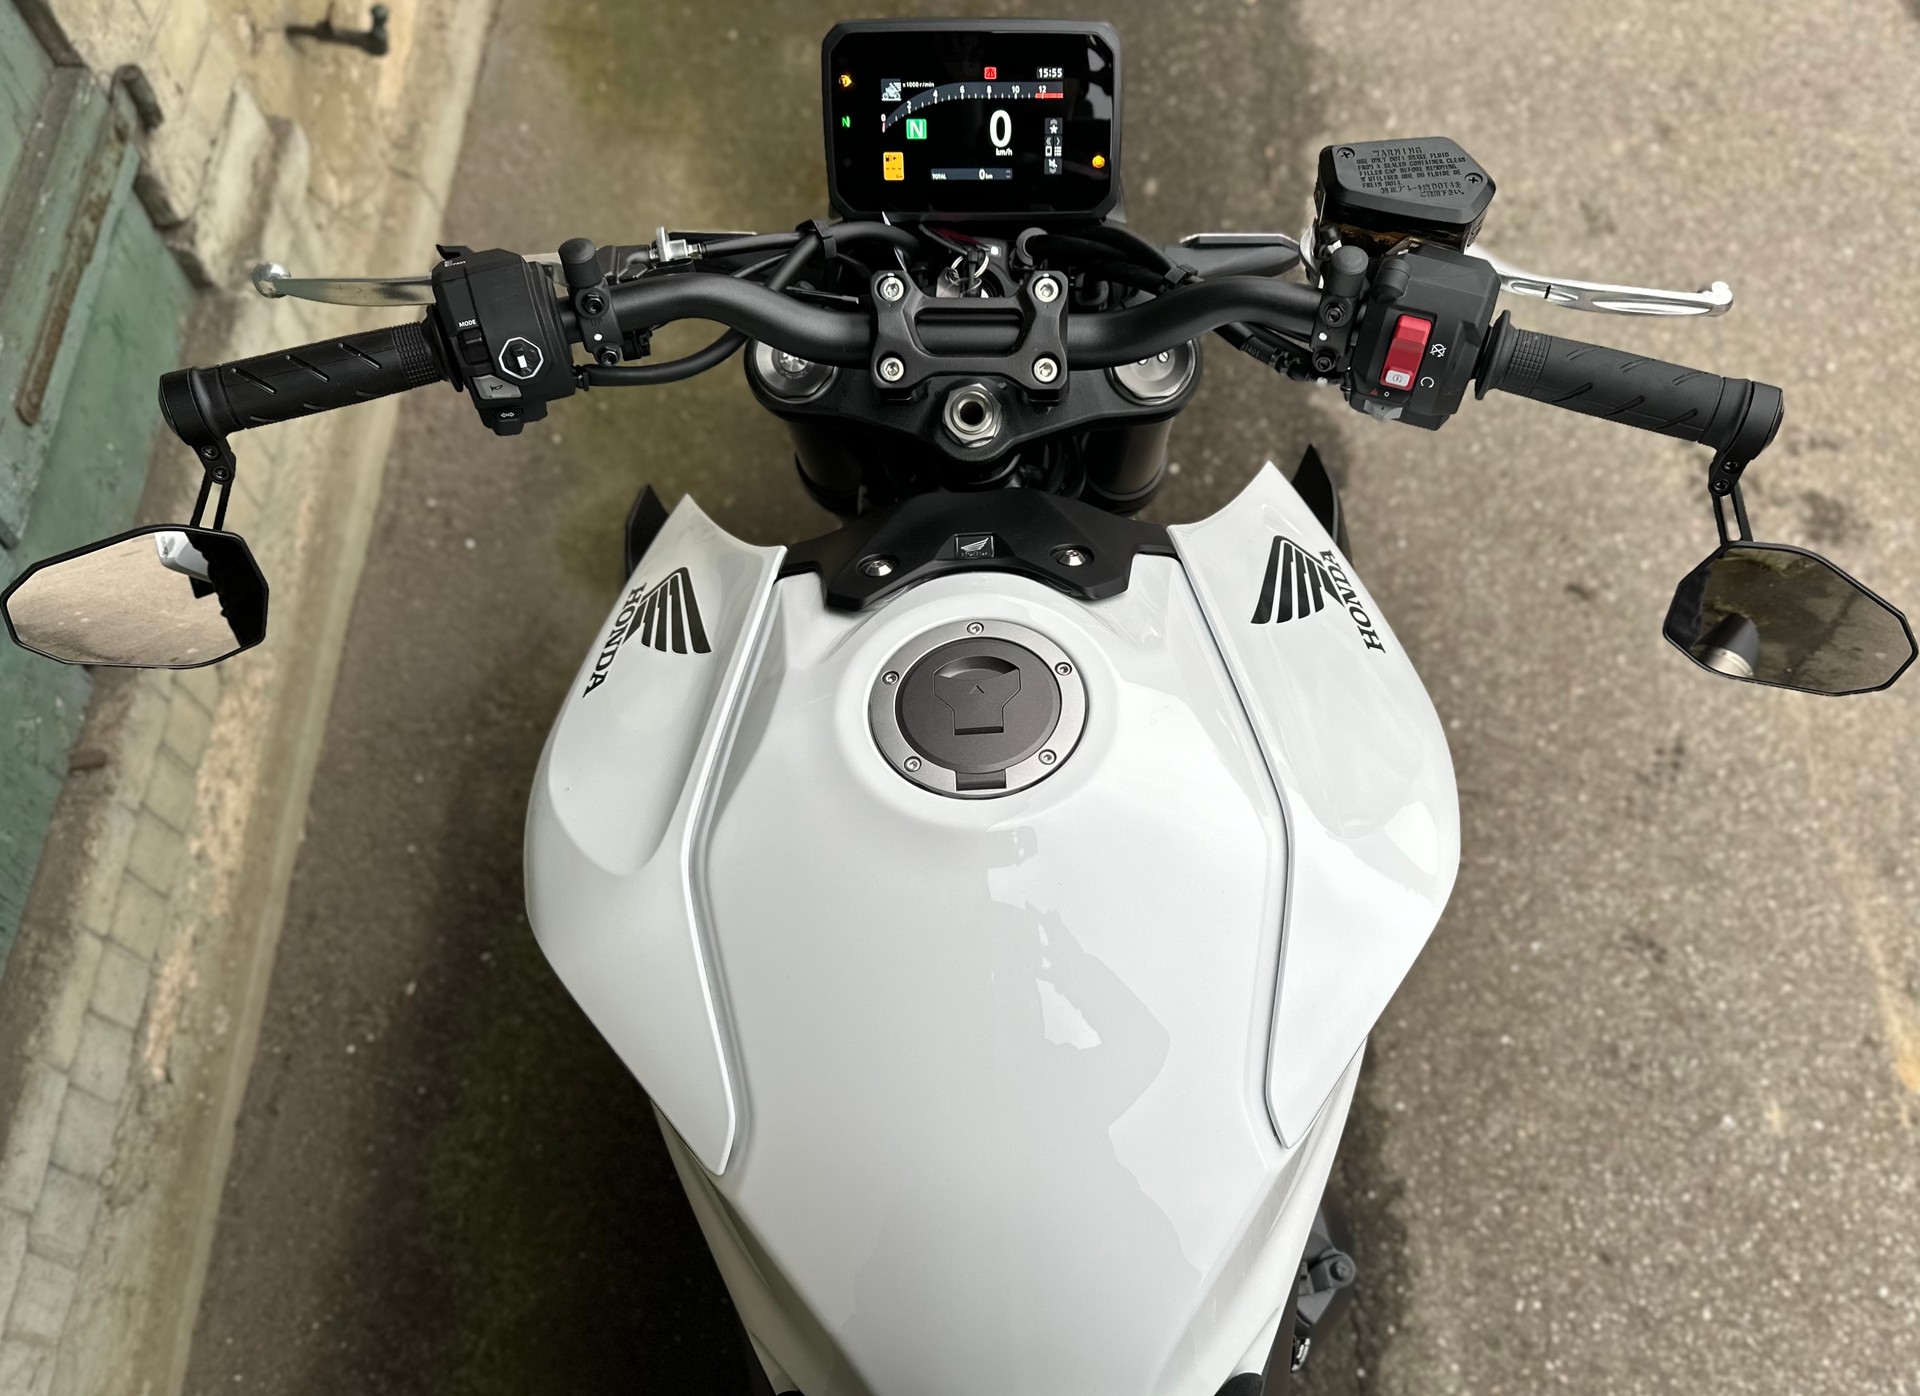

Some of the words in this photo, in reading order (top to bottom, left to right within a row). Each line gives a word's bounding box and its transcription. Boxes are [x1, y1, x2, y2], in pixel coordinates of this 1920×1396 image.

[1038, 67, 1062, 78] 15:55
[960, 85, 965, 93] 6
[986, 85, 992, 93] 8
[1011, 85, 1020, 93] 10
[1039, 85, 1047, 93] 12
[841, 115, 851, 128] N
[909, 119, 924, 139] N
[989, 109, 1012, 148] 0
[995, 147, 1013, 156] km/h
[978, 168, 985, 180] 0
[458, 318, 477, 328] MODE
[1319, 549, 1387, 654] HONDA
[582, 582, 647, 698] HONDA
